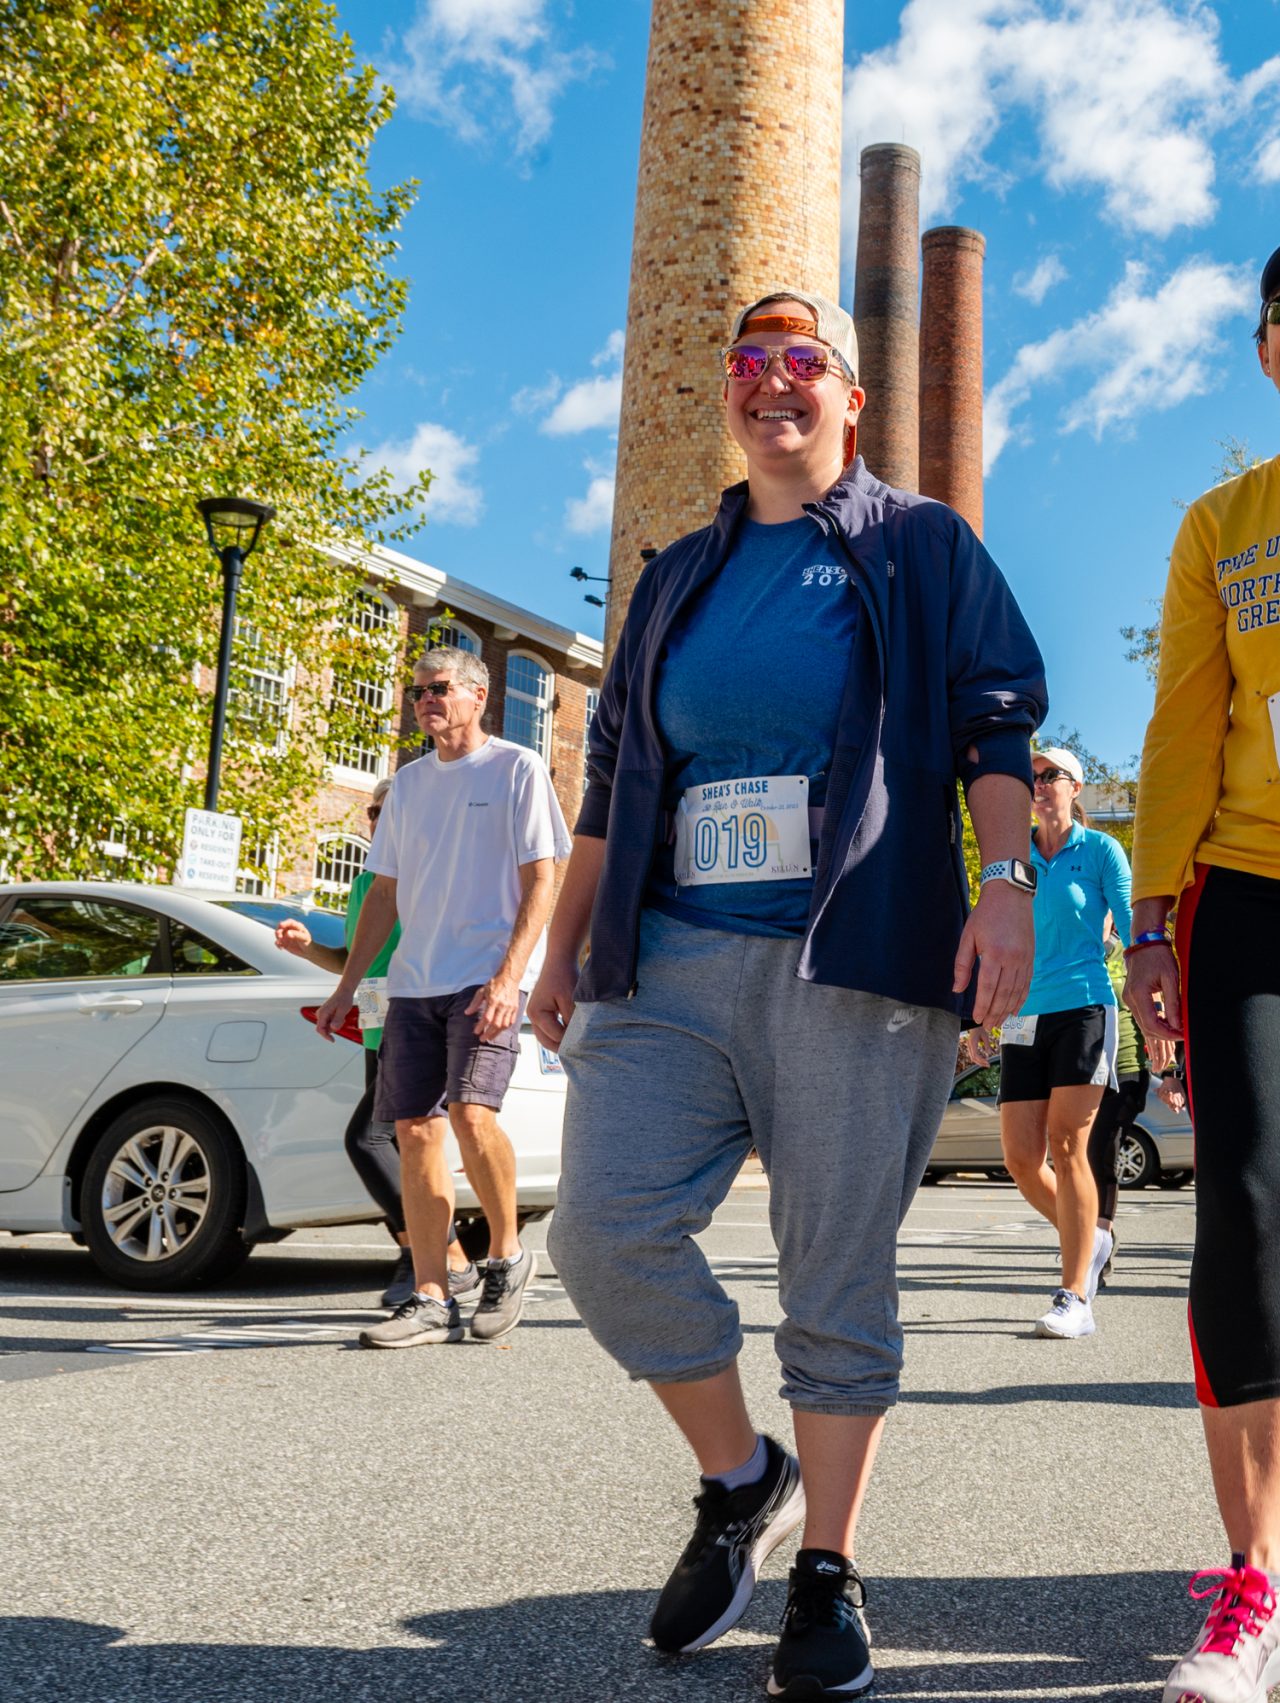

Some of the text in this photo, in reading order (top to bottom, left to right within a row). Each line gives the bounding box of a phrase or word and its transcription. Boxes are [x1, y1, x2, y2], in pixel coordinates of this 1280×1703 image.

[1217, 544, 1258, 582] THE
[702, 780, 769, 800] SHEA'S CHASE
[191, 825, 215, 838] ONLY
[192, 814, 236, 831] PARKNG
[695, 812, 767, 871] 019
